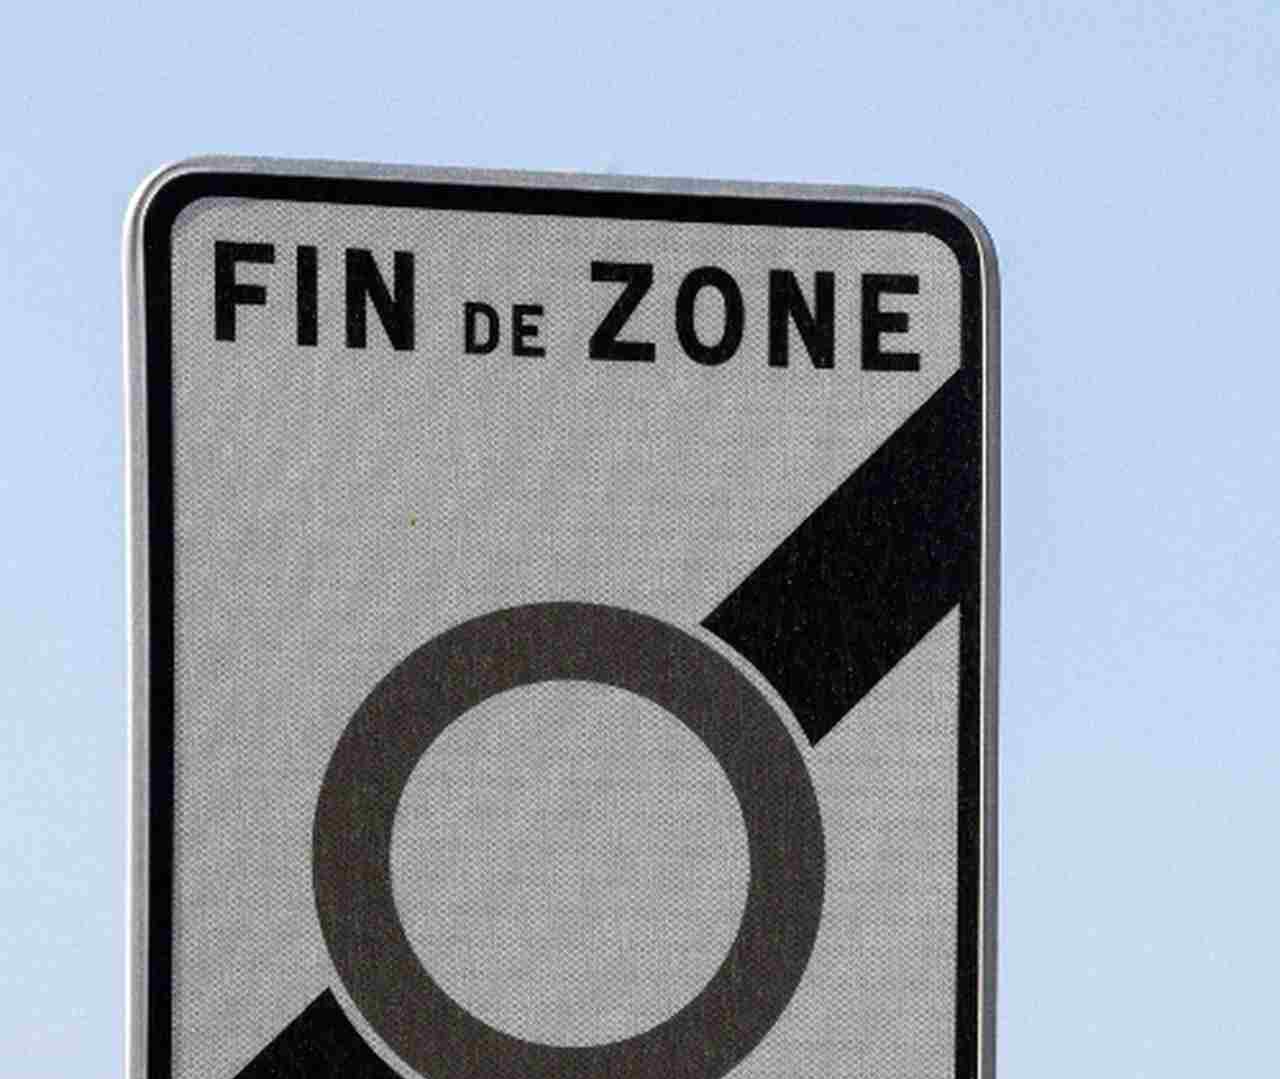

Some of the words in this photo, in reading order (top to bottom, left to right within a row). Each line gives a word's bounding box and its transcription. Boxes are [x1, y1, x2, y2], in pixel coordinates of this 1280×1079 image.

[213, 240, 416, 352] FIN
[463, 300, 547, 358] DE
[588, 260, 921, 373] ZONE
